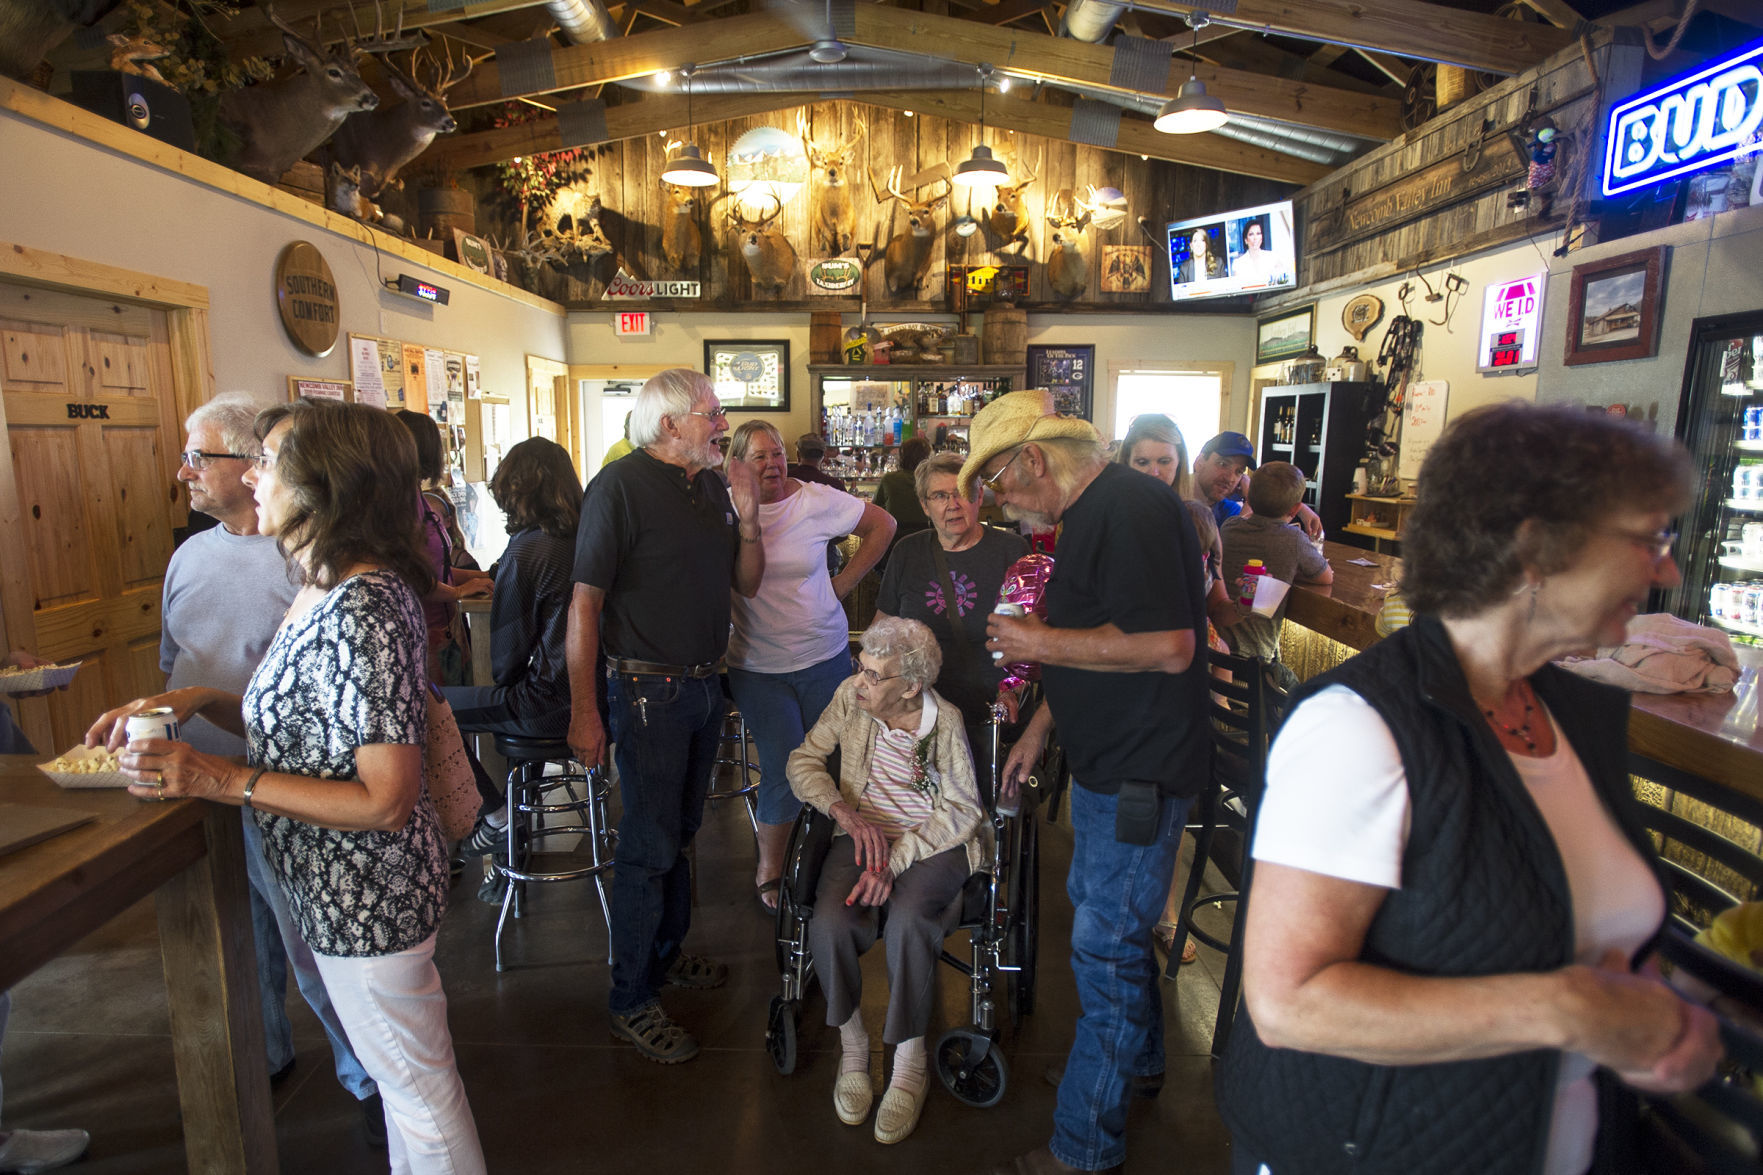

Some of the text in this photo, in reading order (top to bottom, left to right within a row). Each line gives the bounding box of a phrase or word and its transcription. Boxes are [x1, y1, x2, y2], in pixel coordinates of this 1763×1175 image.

[1612, 63, 1763, 178] BUD
[286, 275, 335, 302] SOUTHERN
[607, 277, 699, 296] Coors LIGHT
[292, 299, 335, 324] COMFORT
[1493, 300, 1514, 320] WE
[621, 313, 645, 333] EXIT
[1072, 359, 1083, 370] 12
[67, 403, 110, 420] BUCK
